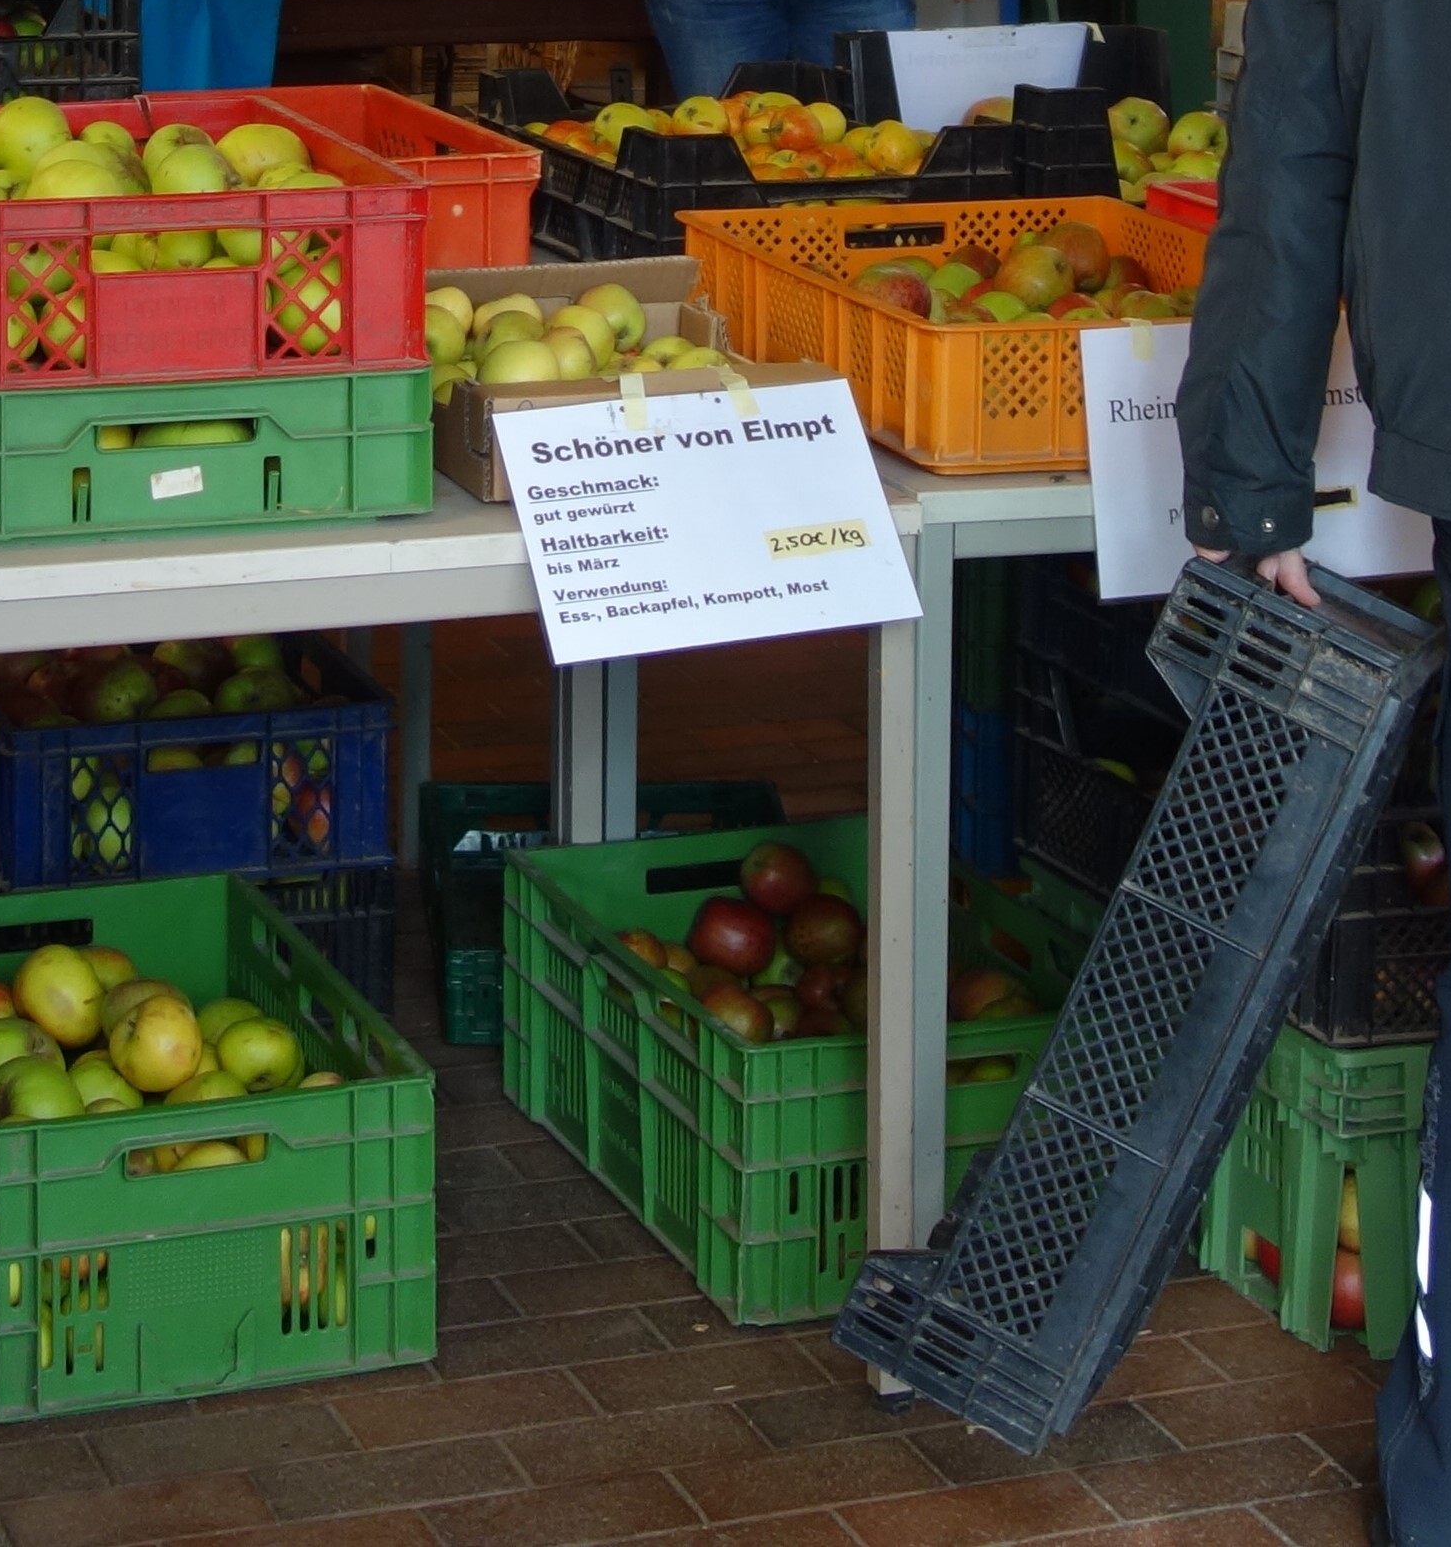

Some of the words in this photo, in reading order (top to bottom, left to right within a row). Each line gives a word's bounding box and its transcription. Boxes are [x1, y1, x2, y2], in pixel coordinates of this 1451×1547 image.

[1110, 395, 1178, 425] Rhein
[531, 434, 666, 464] Schöner
[675, 428, 734, 449] von
[741, 414, 836, 442] Elmpt
[527, 474, 660, 504] Geschmack:
[533, 509, 563, 526] gut
[566, 501, 636, 523] gewürzt
[540, 526, 669, 553] Haltbarkeit:
[546, 562, 573, 576] bis
[577, 558, 620, 572] März
[552, 579, 670, 604] Verwendung:
[558, 610, 602, 625] Ess-,
[605, 593, 700, 619] Backapfel,
[703, 585, 784, 606] Kompott,
[786, 579, 829, 596] Most
